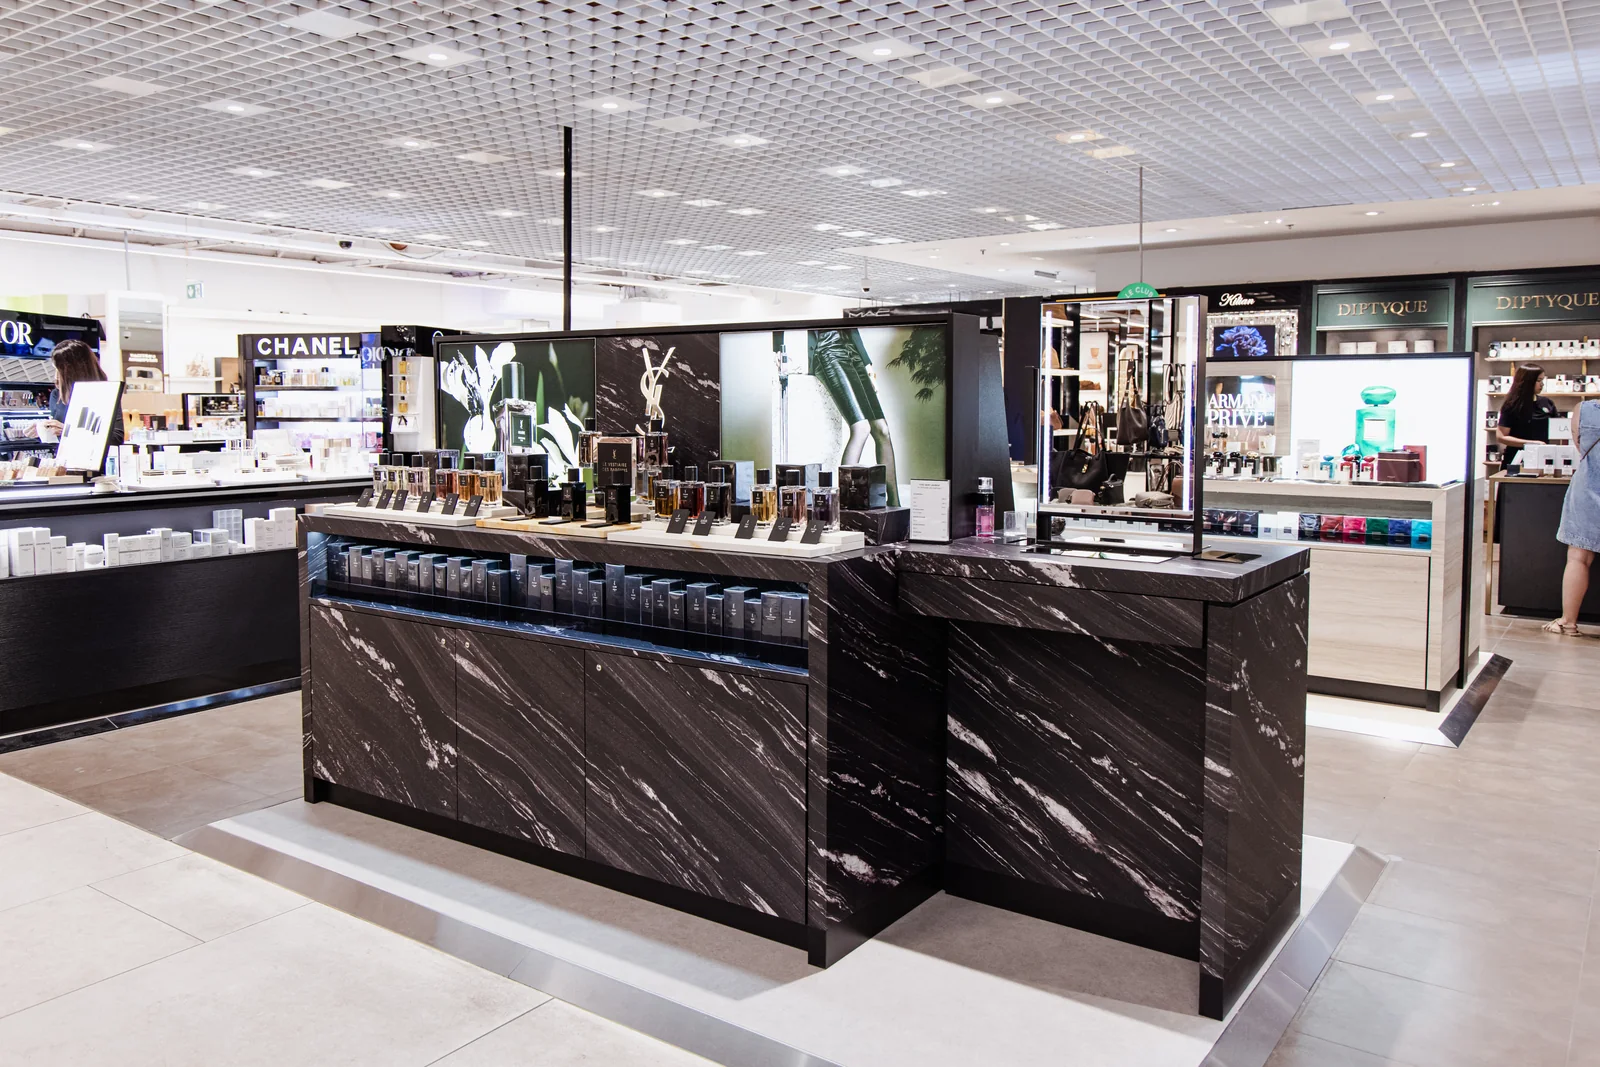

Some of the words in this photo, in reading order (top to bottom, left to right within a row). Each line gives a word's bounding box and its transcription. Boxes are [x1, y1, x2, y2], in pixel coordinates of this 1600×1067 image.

[1124, 289, 1134, 299] LE
[1135, 286, 1154, 298] CLUB
[1219, 293, 1255, 306] Kilian
[1495, 291, 1600, 311] DIPTYQUE
[1337, 300, 1429, 317] DIPTYQUE
[0, 320, 34, 346] OR
[257, 336, 358, 356] CHANEL
